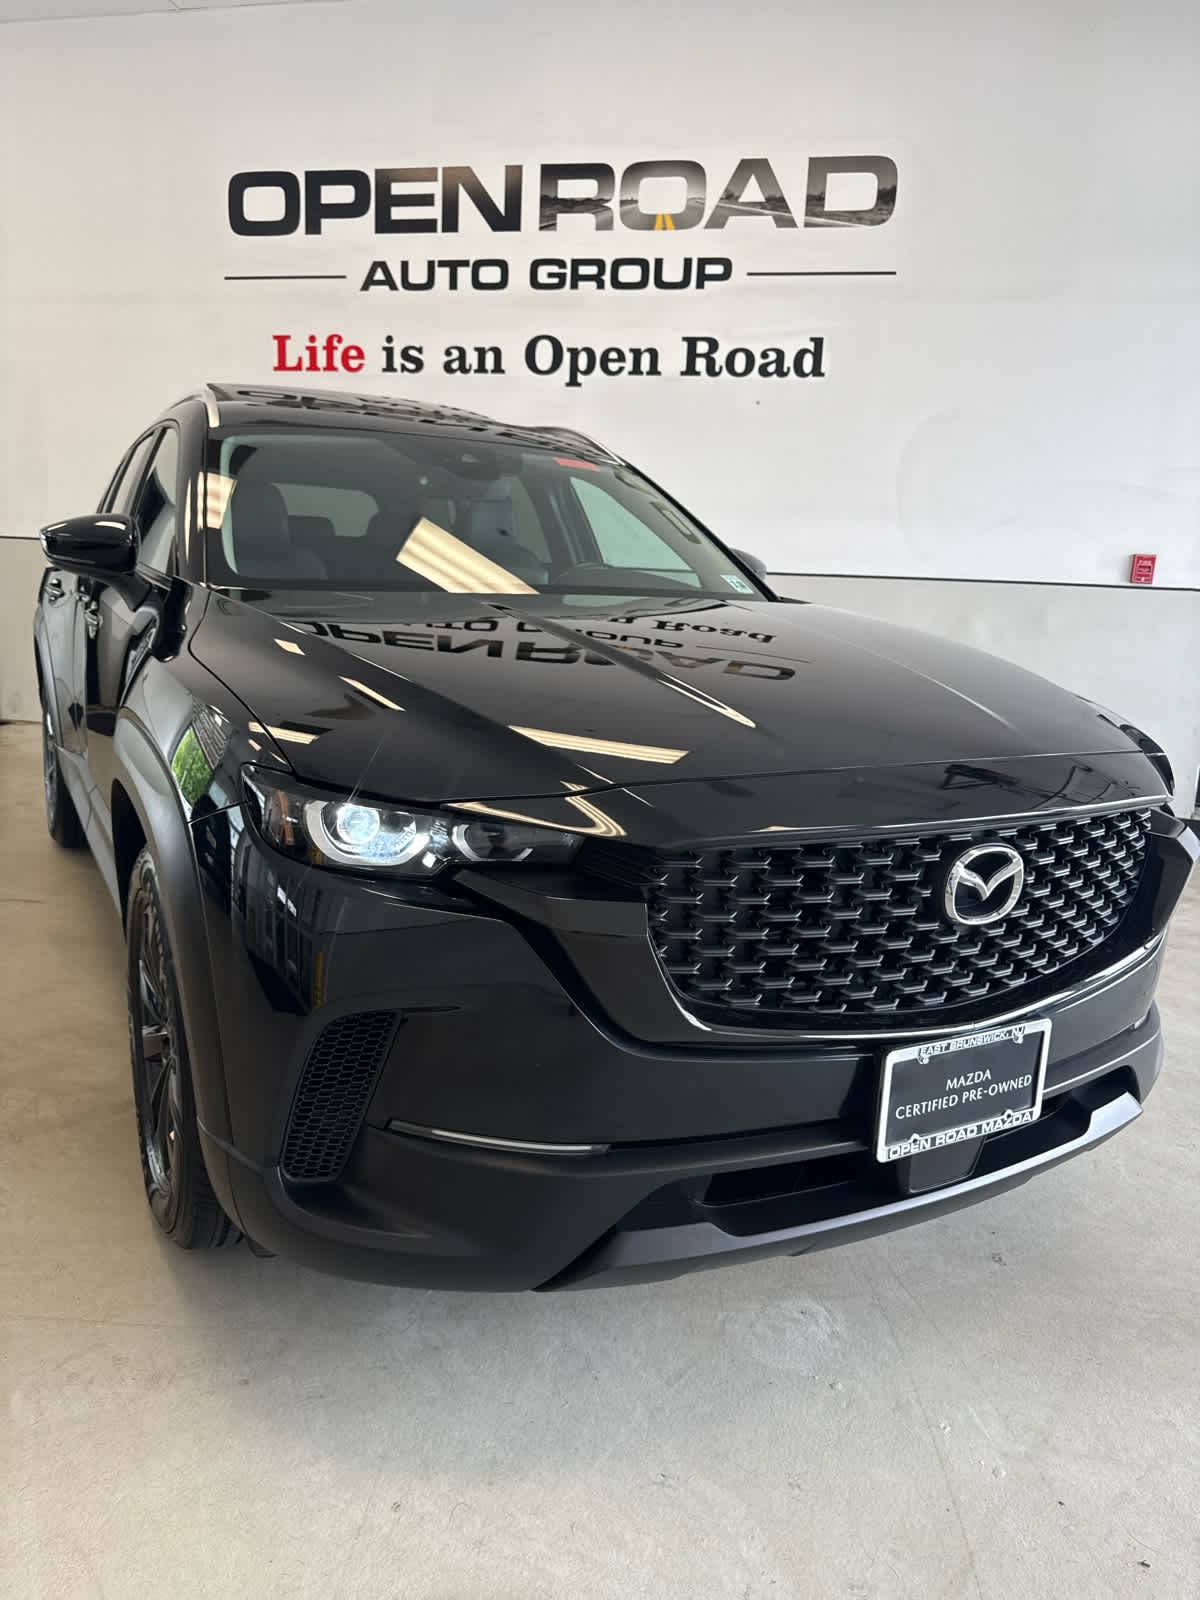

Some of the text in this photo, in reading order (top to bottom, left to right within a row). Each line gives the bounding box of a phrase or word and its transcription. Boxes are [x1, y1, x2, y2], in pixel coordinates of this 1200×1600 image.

[228, 155, 898, 236] OPEN ROAD
[359, 257, 733, 292] AUTO GROUP
[272, 334, 825, 388] Life is an Open Road
[919, 1043, 947, 1056] EAST
[895, 1074, 1033, 1120] CERTIFIED PRE-OWNED
[946, 1069, 992, 1091] MAZDA
[889, 1112, 1032, 1159] OPEN ROAD MAZDA
